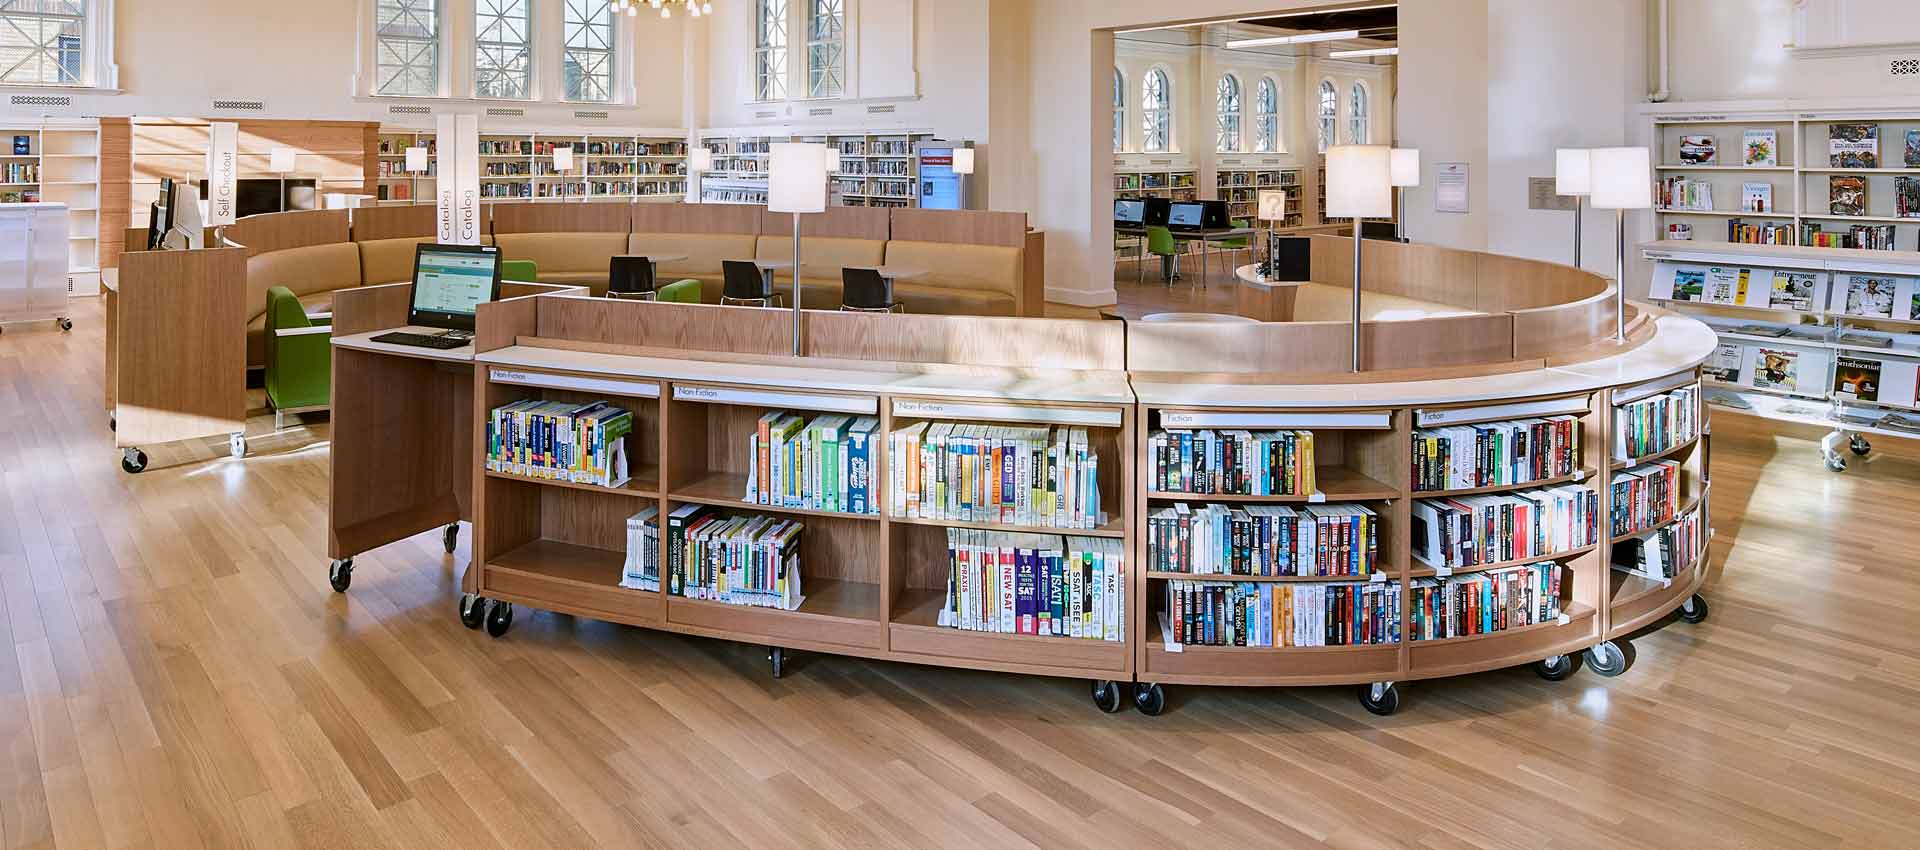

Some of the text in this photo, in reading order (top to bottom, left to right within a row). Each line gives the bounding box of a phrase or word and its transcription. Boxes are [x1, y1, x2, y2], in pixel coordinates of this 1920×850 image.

[217, 152, 232, 217] Self Checkout
[440, 190, 451, 240] Catalog
[460, 190, 474, 240] Catalog
[1774, 271, 1817, 280] Entreneur
[1849, 276, 1896, 286] ESSCE
[1836, 360, 1880, 371] Smithsonian
[493, 371, 526, 381] Non Fiction
[678, 388, 717, 397] Non Fiction
[898, 401, 943, 412] Non Fiction
[1167, 414, 1193, 423] Fiction
[1424, 412, 1445, 422] Fiction
[1004, 455, 1013, 473] GED
[1020, 565, 1032, 574] 12
[1004, 567, 1012, 611] NEW SAT
[1018, 587, 1035, 595] SAT
[1093, 574, 1102, 600] TASC
